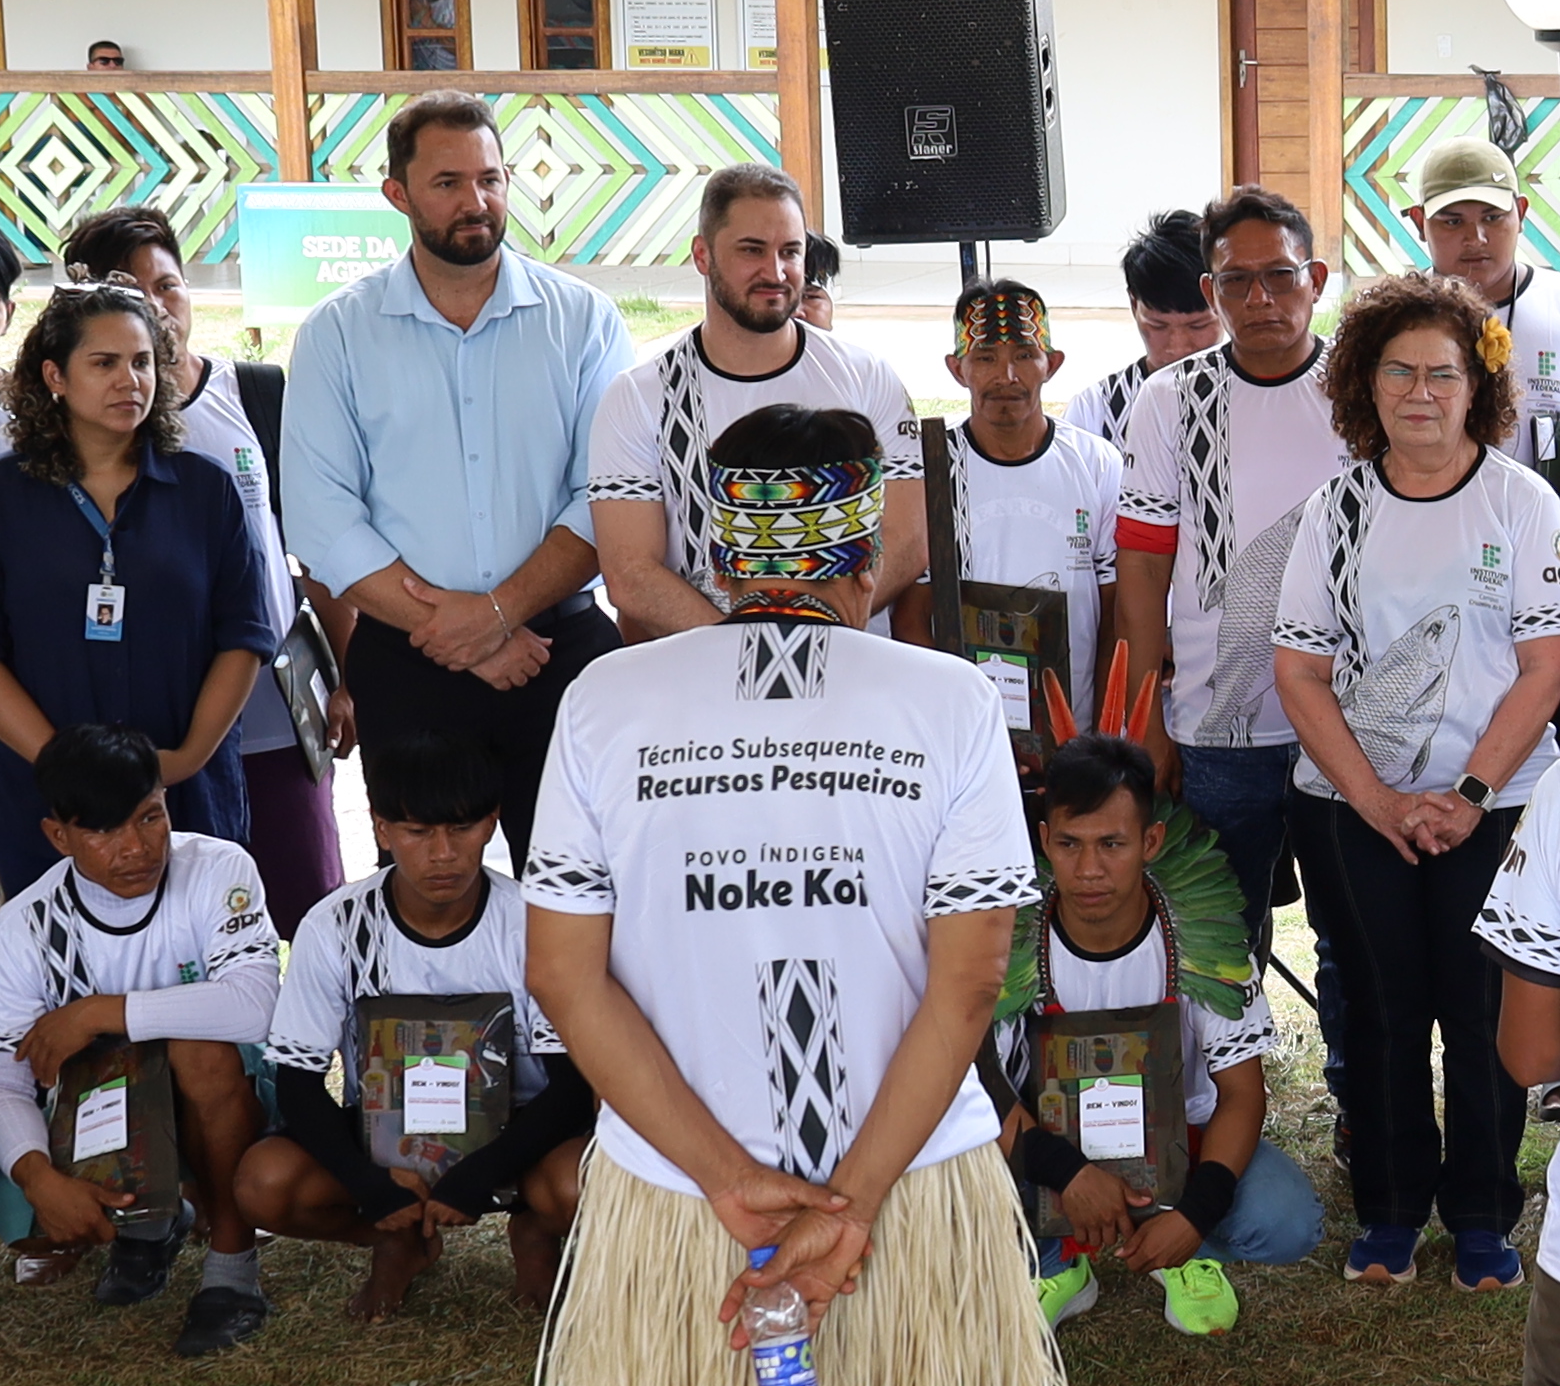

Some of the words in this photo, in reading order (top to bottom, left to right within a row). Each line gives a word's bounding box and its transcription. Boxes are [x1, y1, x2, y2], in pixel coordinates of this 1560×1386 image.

[302, 235, 362, 259] SEDE
[365, 235, 401, 260] DA
[637, 739, 724, 768] Técnico
[731, 736, 885, 763] Subsequente
[890, 749, 925, 769] em
[637, 771, 763, 802] Recursos
[770, 765, 922, 801] Pesqueiros
[685, 849, 747, 868] POVO
[760, 843, 865, 864] ÍNDIGENA
[685, 869, 793, 913] Noke
